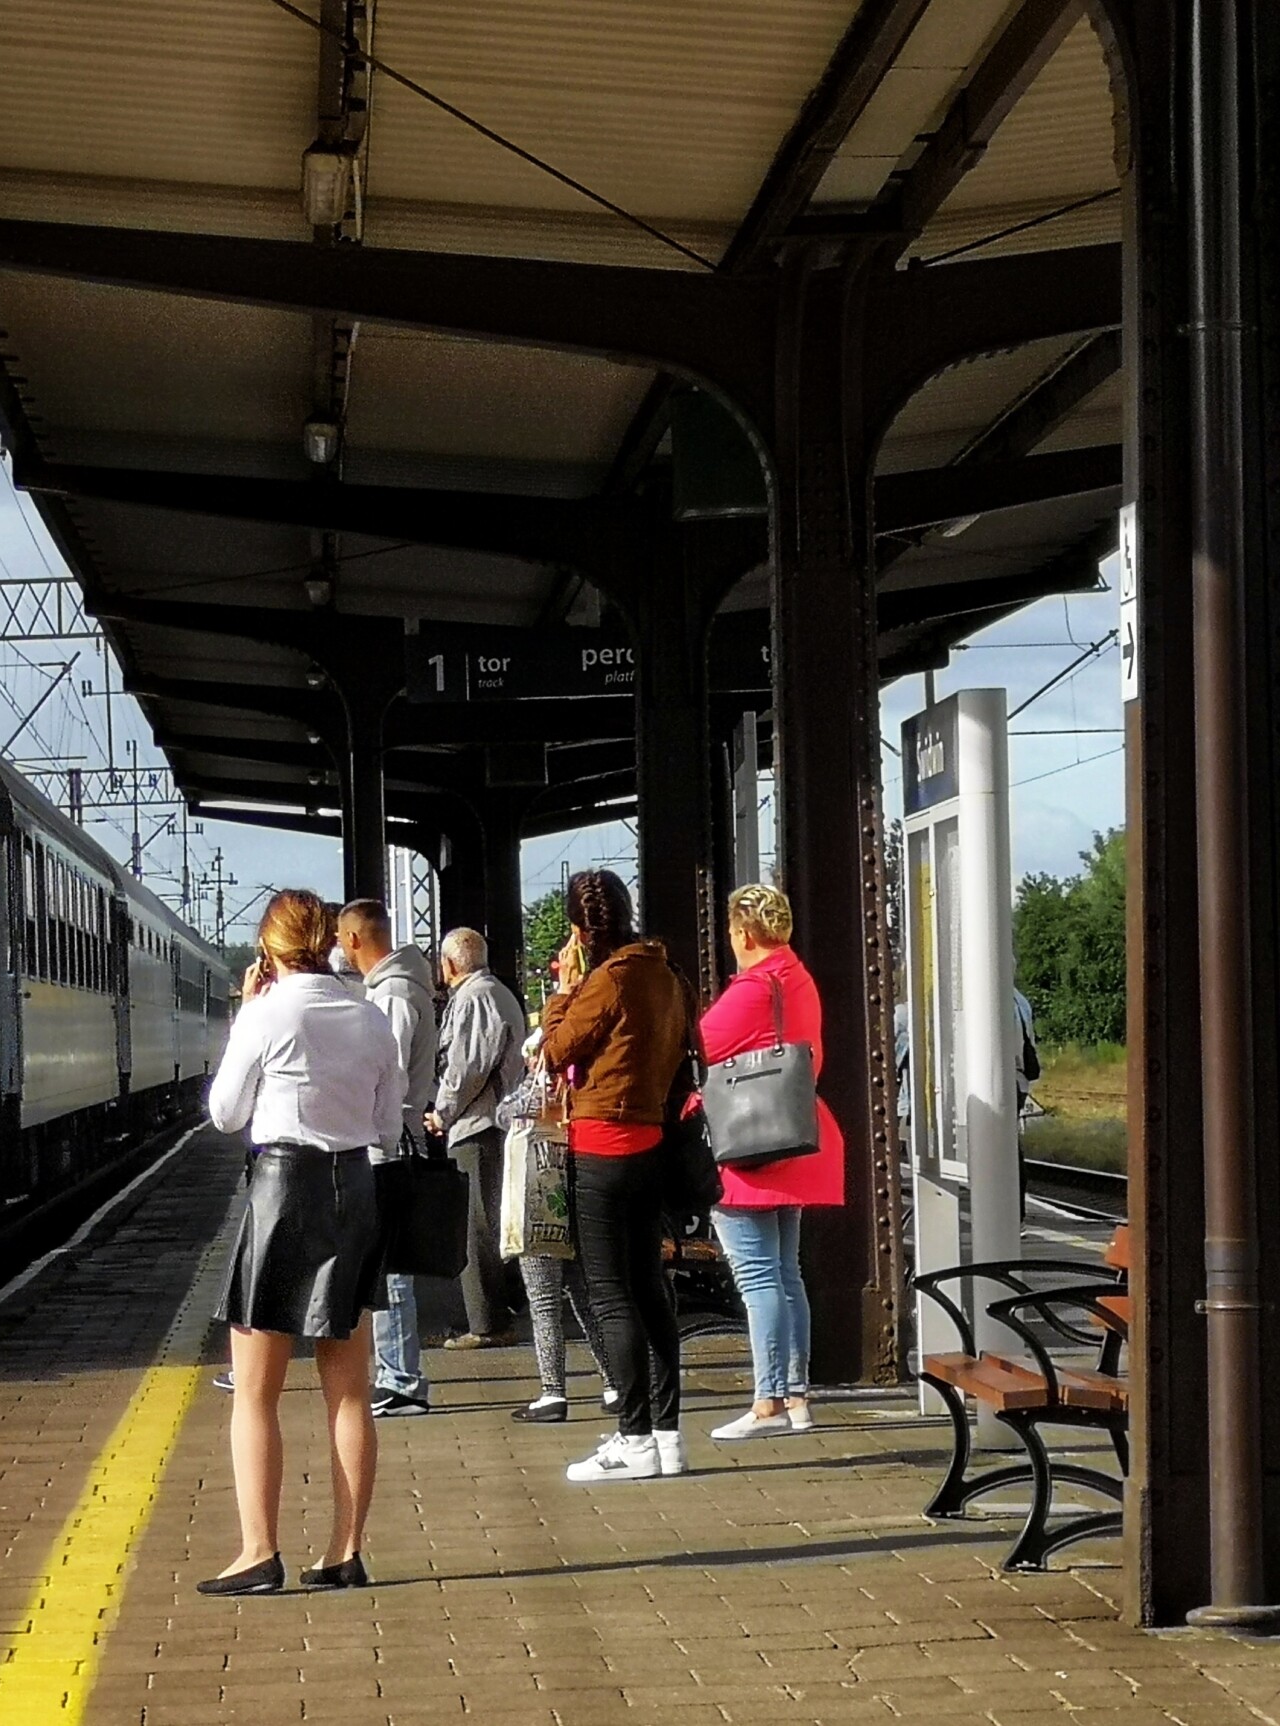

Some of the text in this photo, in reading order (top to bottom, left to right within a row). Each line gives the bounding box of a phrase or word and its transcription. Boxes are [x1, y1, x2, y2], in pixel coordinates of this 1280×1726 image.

[581, 648, 635, 672] per
[428, 654, 511, 692] 1 tor
[478, 677, 505, 688] track
